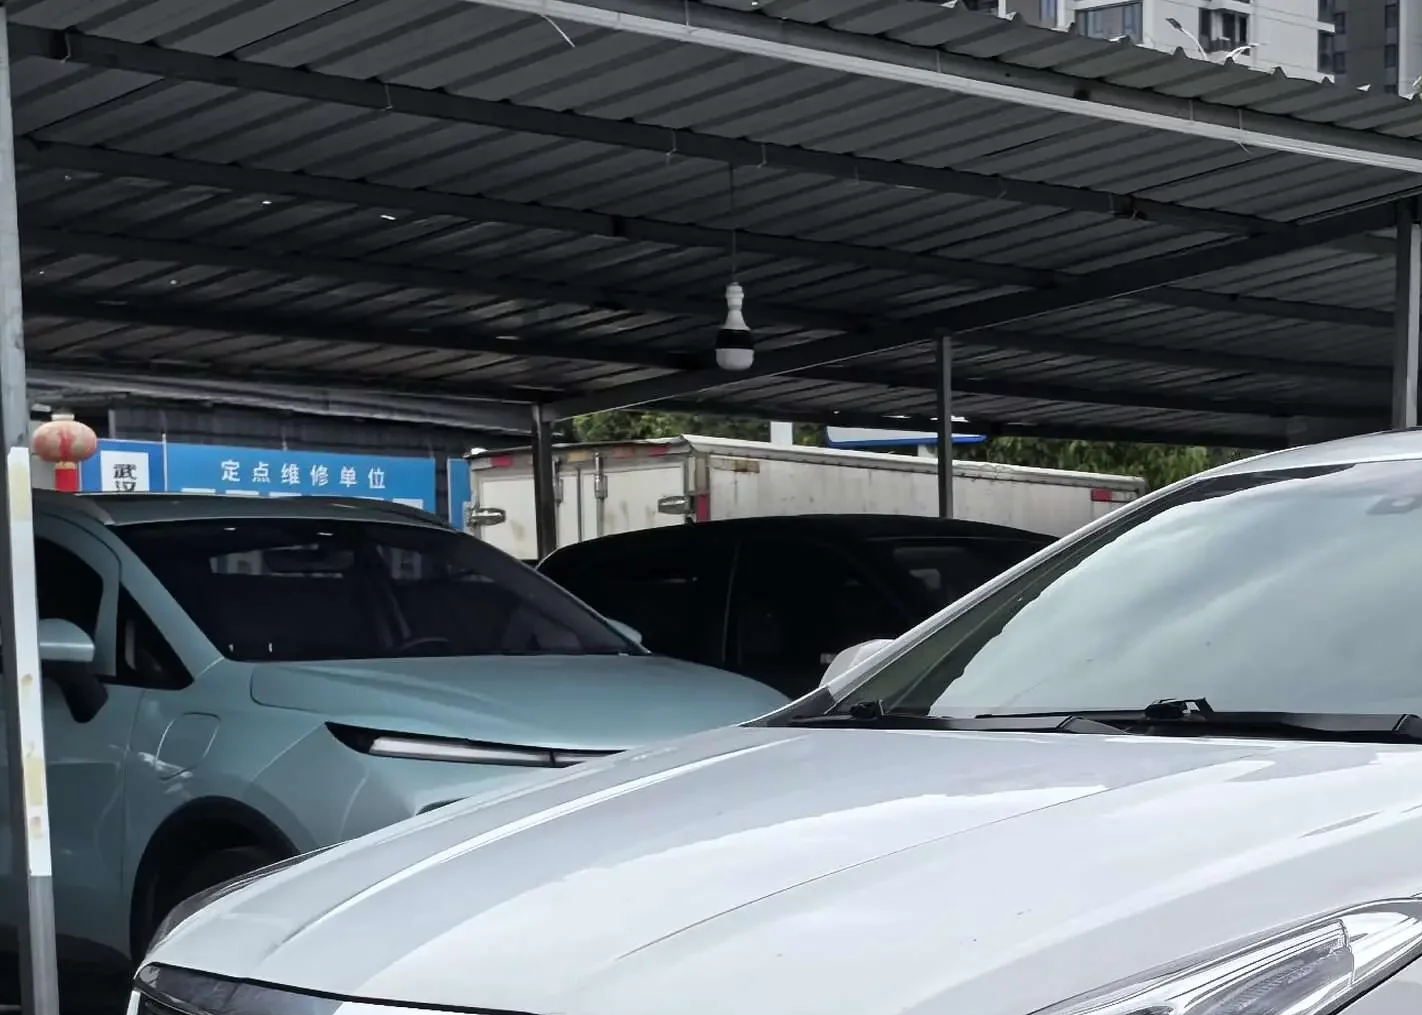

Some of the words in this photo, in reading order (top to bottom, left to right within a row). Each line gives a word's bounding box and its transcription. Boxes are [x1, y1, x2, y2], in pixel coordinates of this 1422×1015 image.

[221, 459, 387, 490] 定点维修单位
